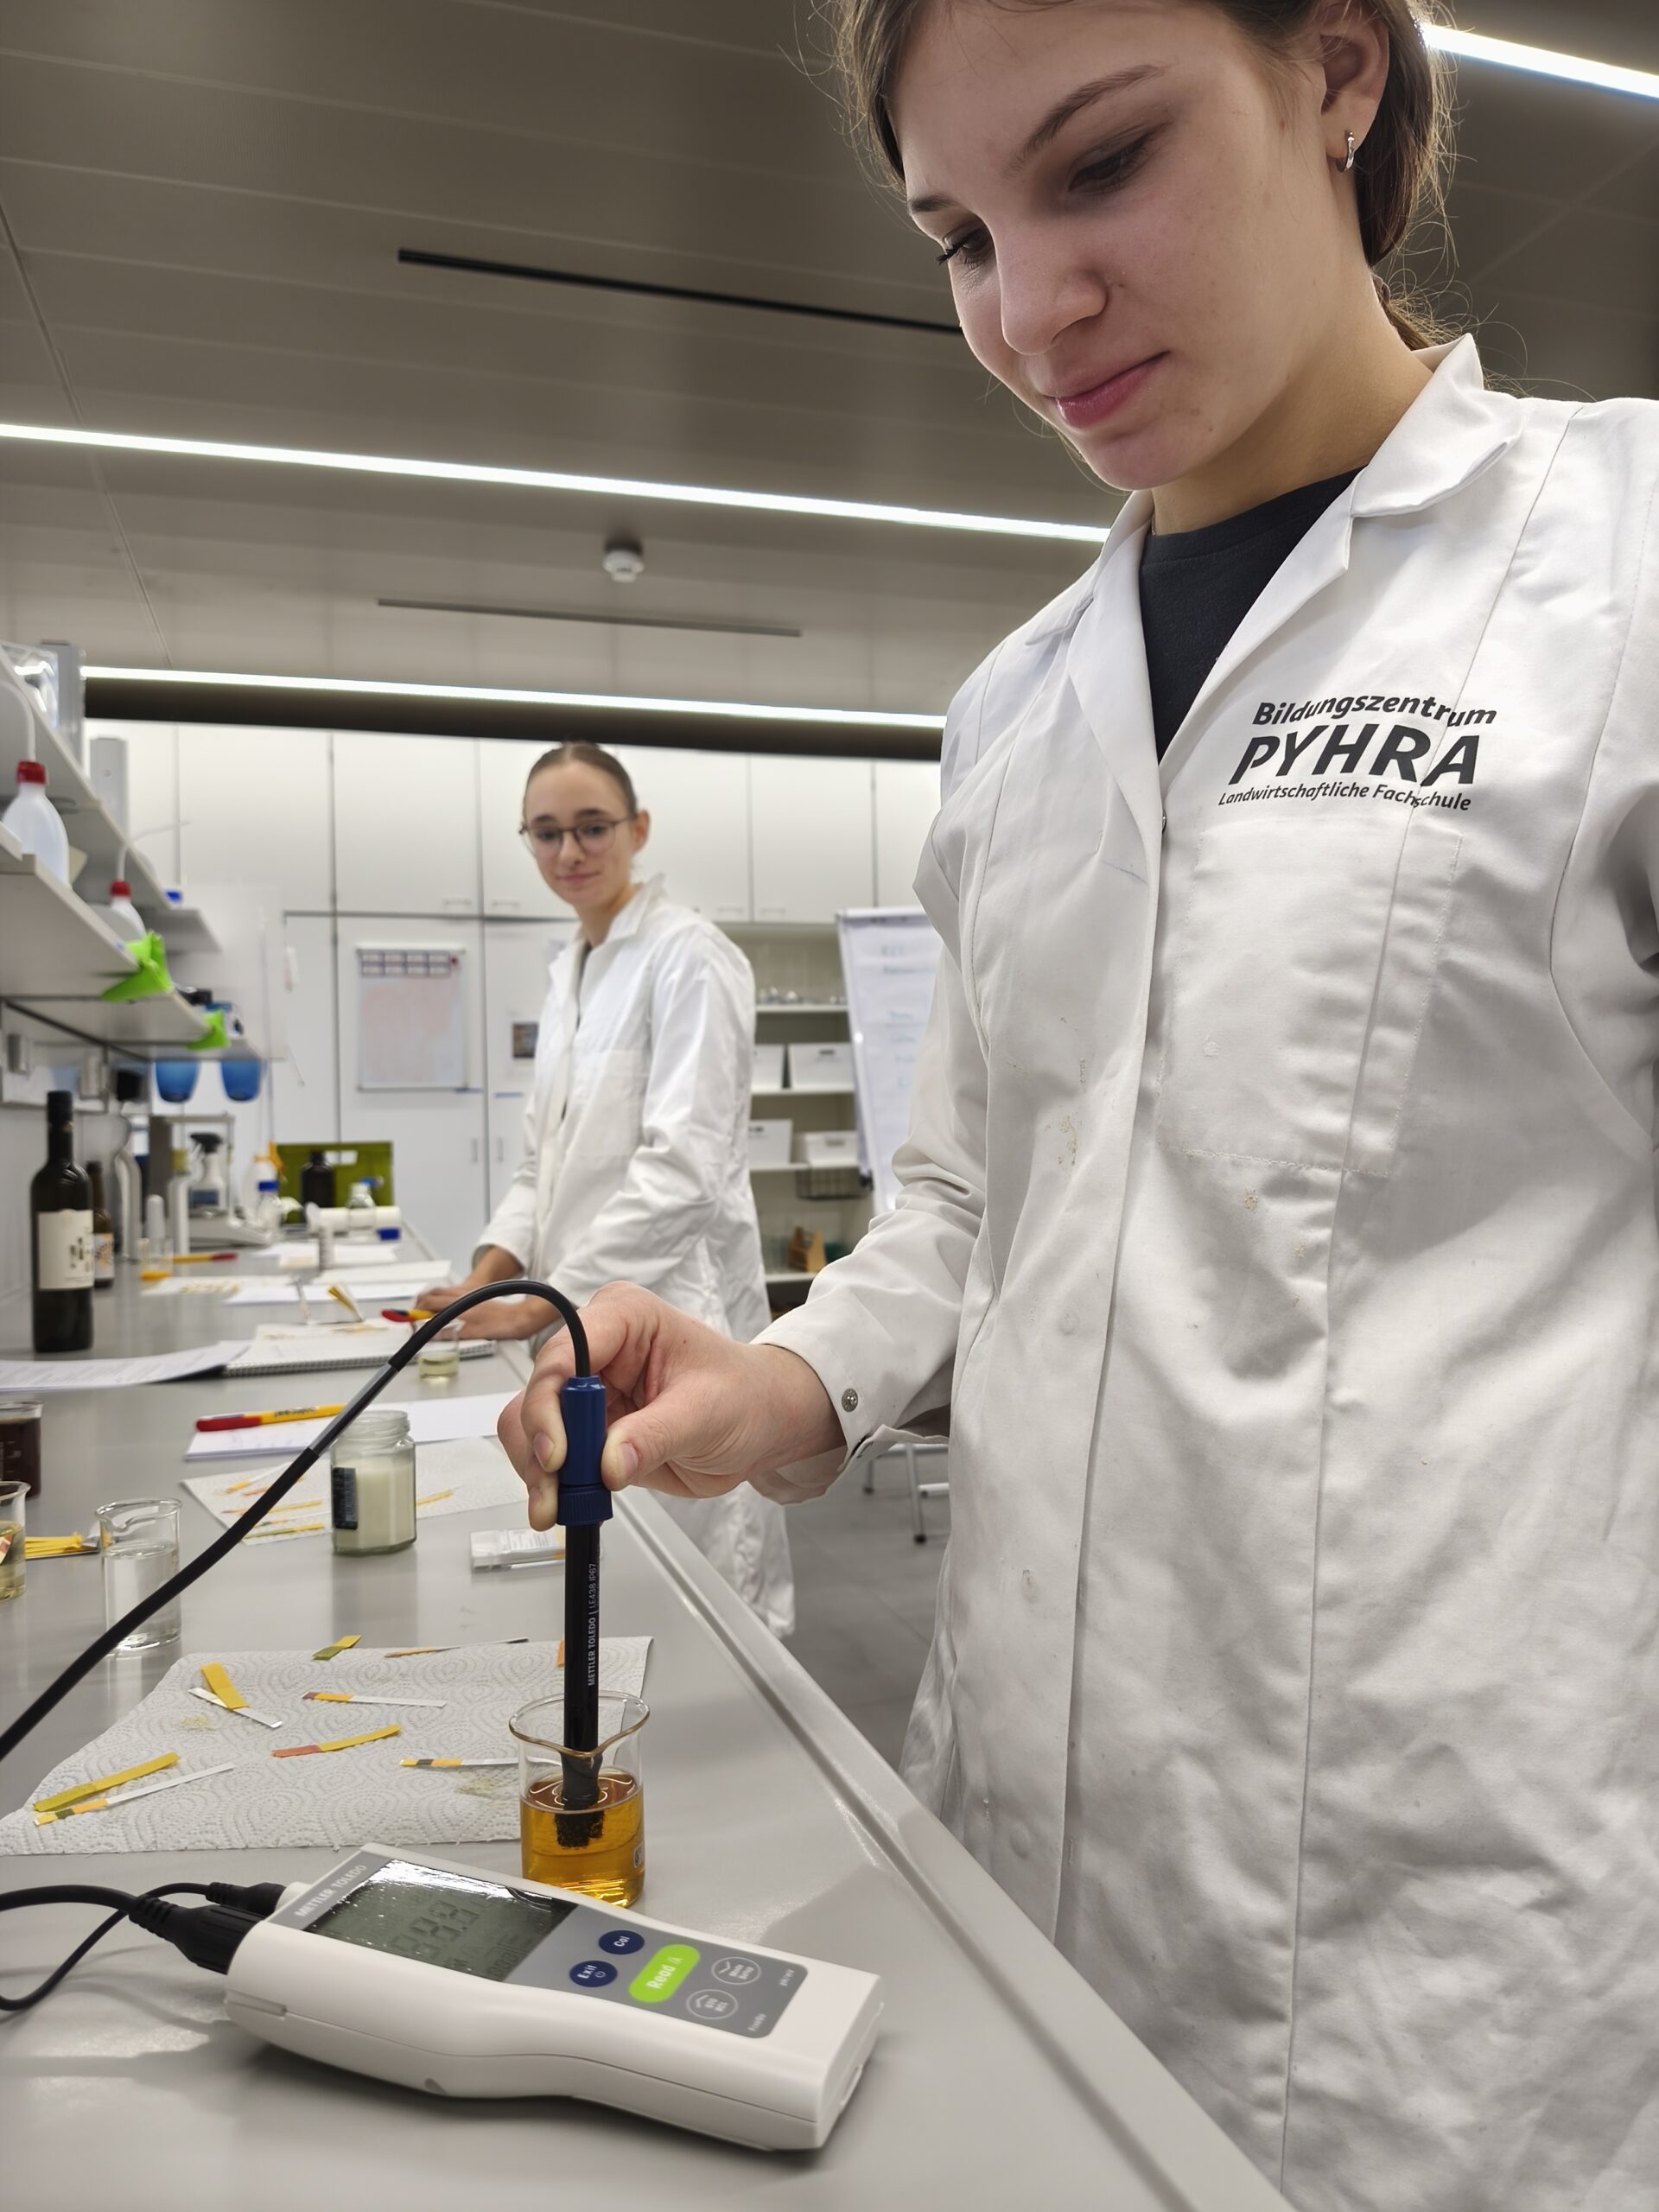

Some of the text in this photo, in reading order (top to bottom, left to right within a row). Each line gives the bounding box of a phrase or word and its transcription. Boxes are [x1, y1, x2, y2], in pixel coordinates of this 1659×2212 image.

[1252, 695, 1497, 728] Bildungszentrum
[1228, 723, 1480, 787] PYHRA
[1217, 781, 1471, 810] Landwirtschaftliche Fachschule
[588, 1651, 596, 1686] METTLER
[295, 1865, 367, 1916] METTLER TOLEDO
[577, 1964, 598, 1980] Exit
[645, 1964, 676, 1989] Read
